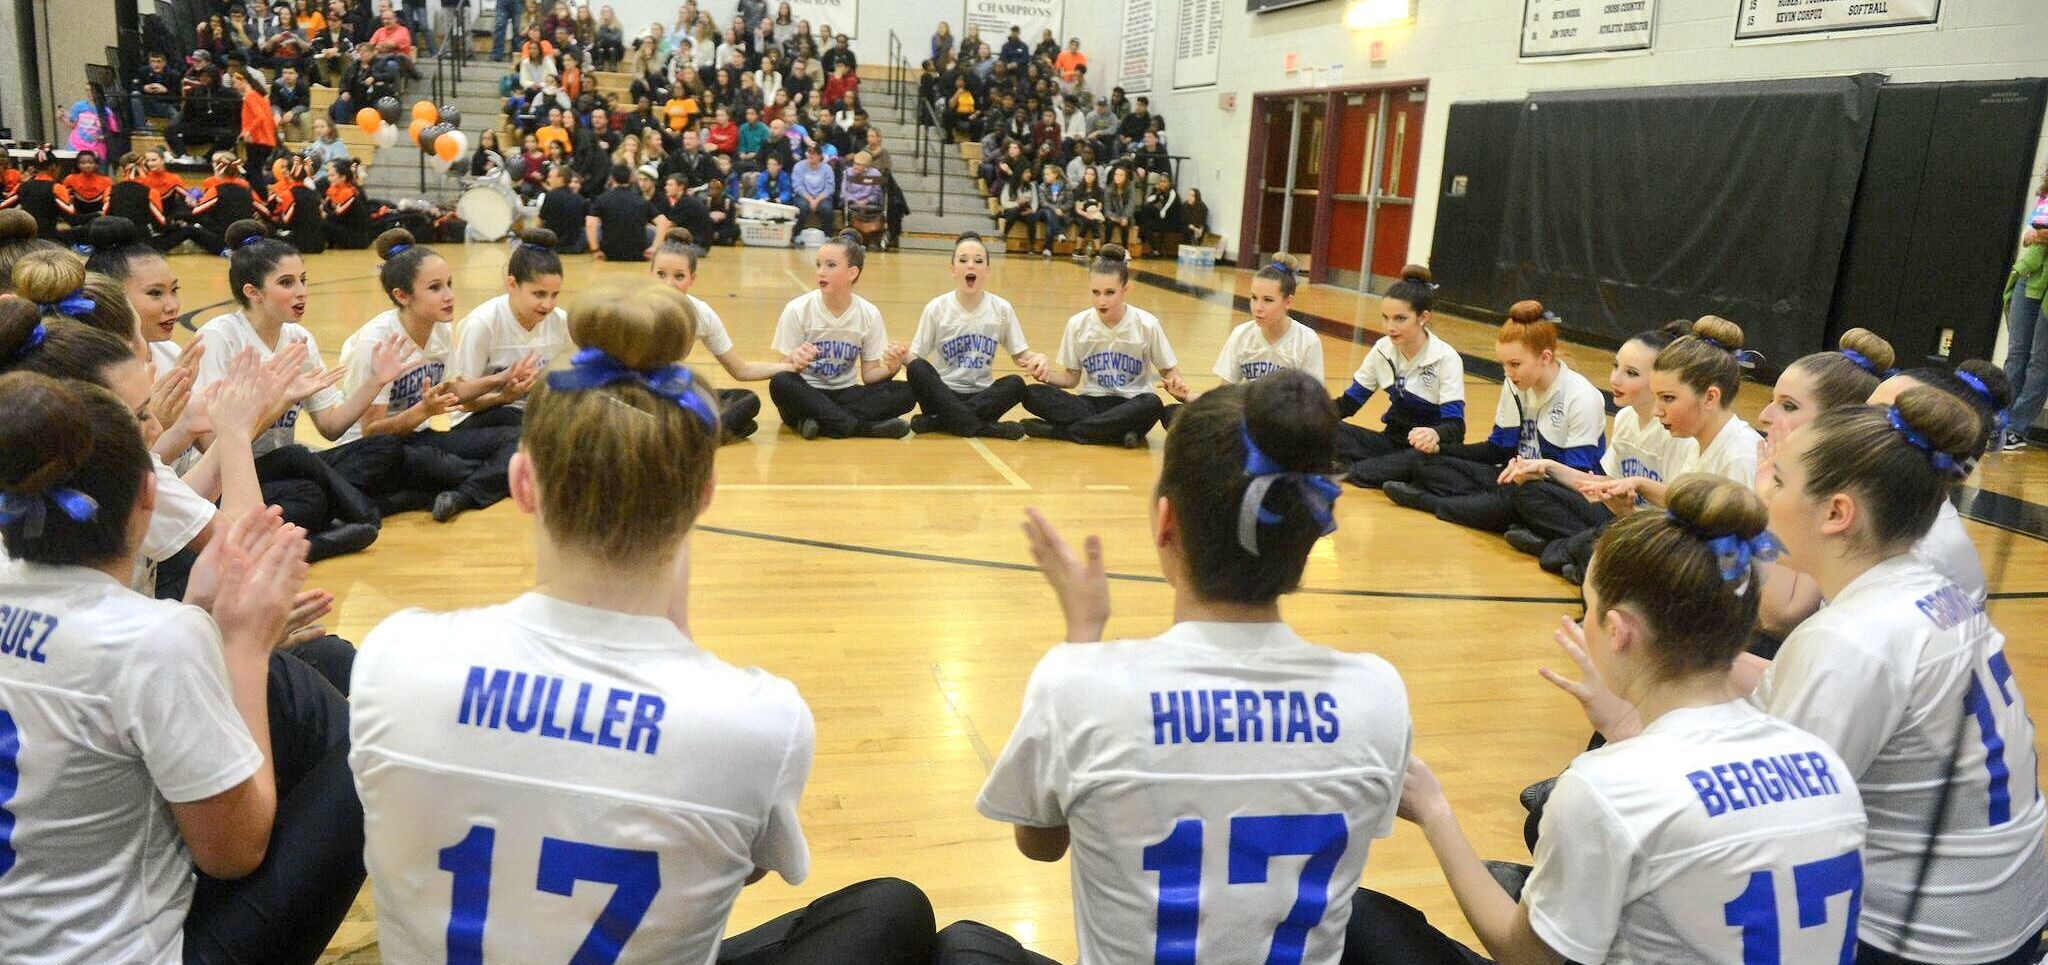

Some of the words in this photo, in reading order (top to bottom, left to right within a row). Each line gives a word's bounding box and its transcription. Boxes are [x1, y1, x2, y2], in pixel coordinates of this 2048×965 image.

[977, 2, 1053, 17] CHAMPIONS
[1776, 12, 1796, 23] KEVIN
[1797, 8, 1823, 20] CORPUZ
[1848, 2, 1888, 15] SOFTBALL
[958, 355, 984, 369] POMS
[1083, 351, 1143, 376] SHERWOOD
[458, 665, 667, 755] MULLER
[1150, 689, 1340, 745] HUERTAS
[1686, 751, 1841, 818] BERGNER
[438, 824, 662, 965] 17
[1143, 813, 1349, 965] 17
[1724, 849, 1864, 965] 17
